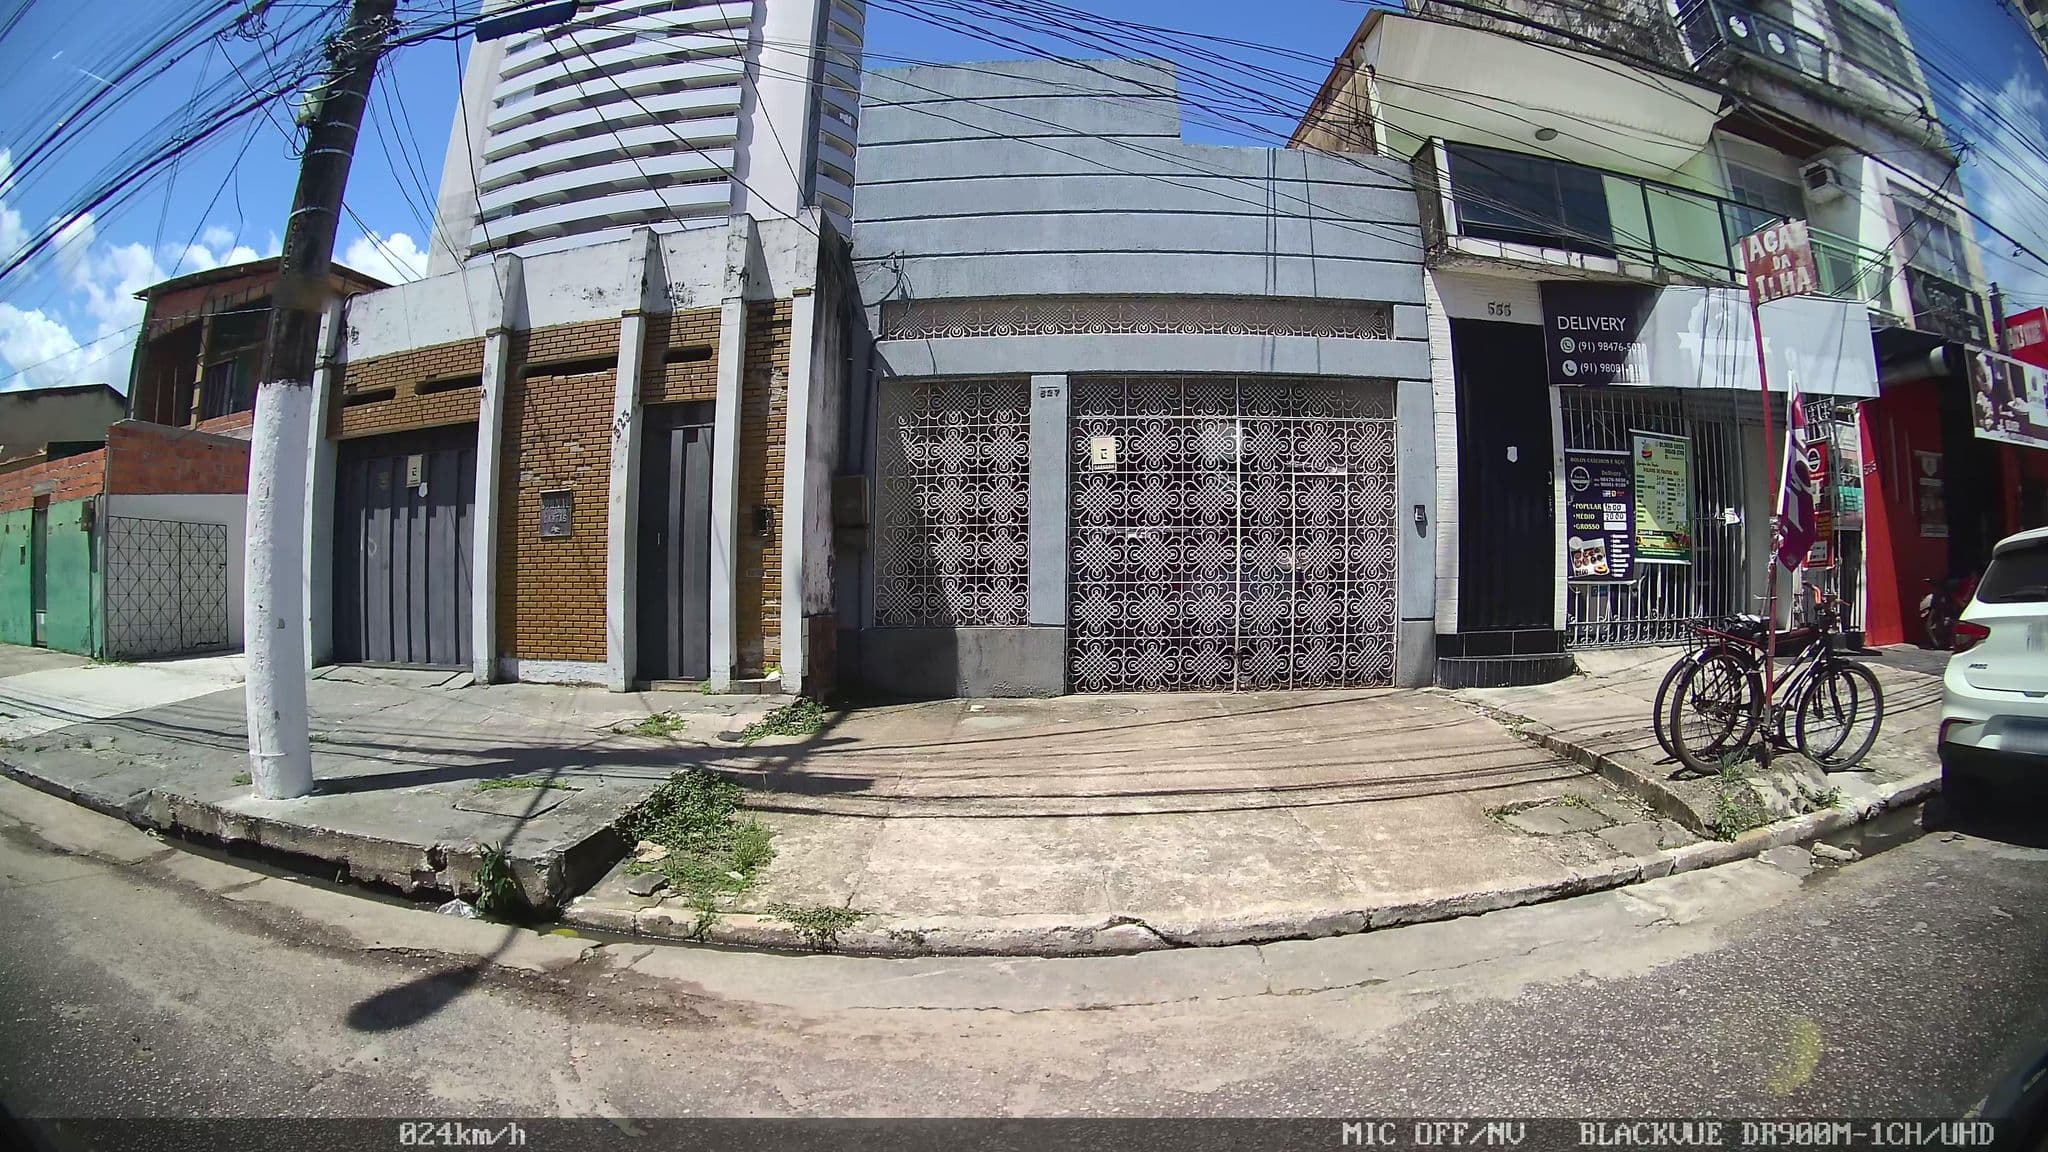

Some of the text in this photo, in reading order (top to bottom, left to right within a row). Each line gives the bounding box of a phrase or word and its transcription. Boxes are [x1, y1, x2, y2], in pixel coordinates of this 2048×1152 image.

[1772, 253, 1792, 271] DA
[1755, 266, 1814, 304] ILHA
[1487, 301, 1512, 317] 555
[1557, 316, 1626, 331] DELIVERY
[1578, 341, 1596, 353] (91)
[1580, 362, 1598, 375] (91)
